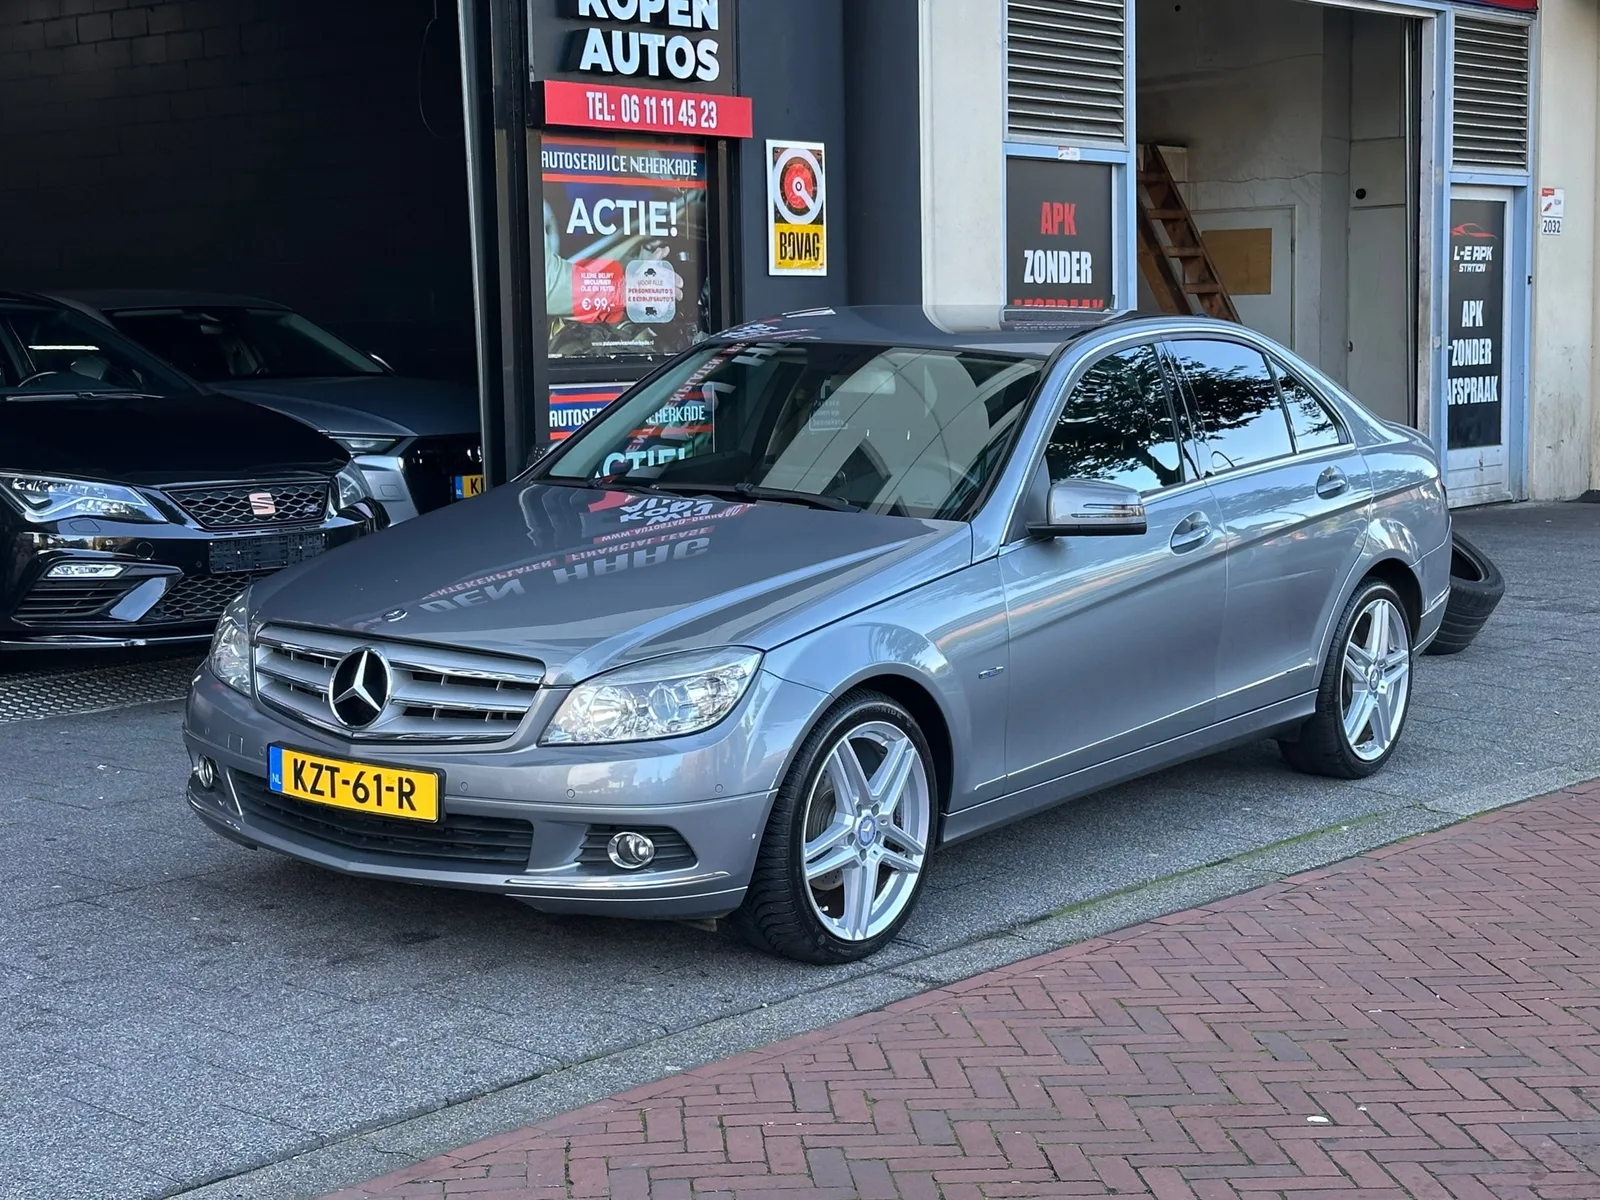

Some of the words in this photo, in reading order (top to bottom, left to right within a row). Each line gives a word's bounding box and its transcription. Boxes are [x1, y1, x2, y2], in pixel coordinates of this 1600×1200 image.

[579, 27, 720, 82] AUTOS
[586, 91, 615, 122] TEL:
[621, 94, 640, 124] 06
[643, 95, 658, 124] 11
[660, 97, 675, 125] 11
[678, 98, 697, 127] 45
[700, 101, 718, 129] 23
[541, 151, 627, 172] AUTOSERVICE
[630, 156, 698, 176] NEHERKADE
[566, 198, 678, 237] ACTIE!
[1040, 202, 1077, 236] APK
[1543, 220, 1561, 233] 2032
[779, 231, 820, 262] BOVAG
[1453, 246, 1473, 262] L-E
[1473, 246, 1493, 261] APK
[1023, 250, 1093, 284] ZONDER
[1458, 263, 1486, 273] STATION
[581, 298, 591, 311] €
[595, 298, 615, 312] 99,-
[1461, 300, 1483, 327] APK
[1451, 338, 1492, 367] ZONDER
[645, 405, 705, 425] EHERKADE
[272, 773, 281, 785] NL
[293, 758, 417, 811] KZT-61-R
